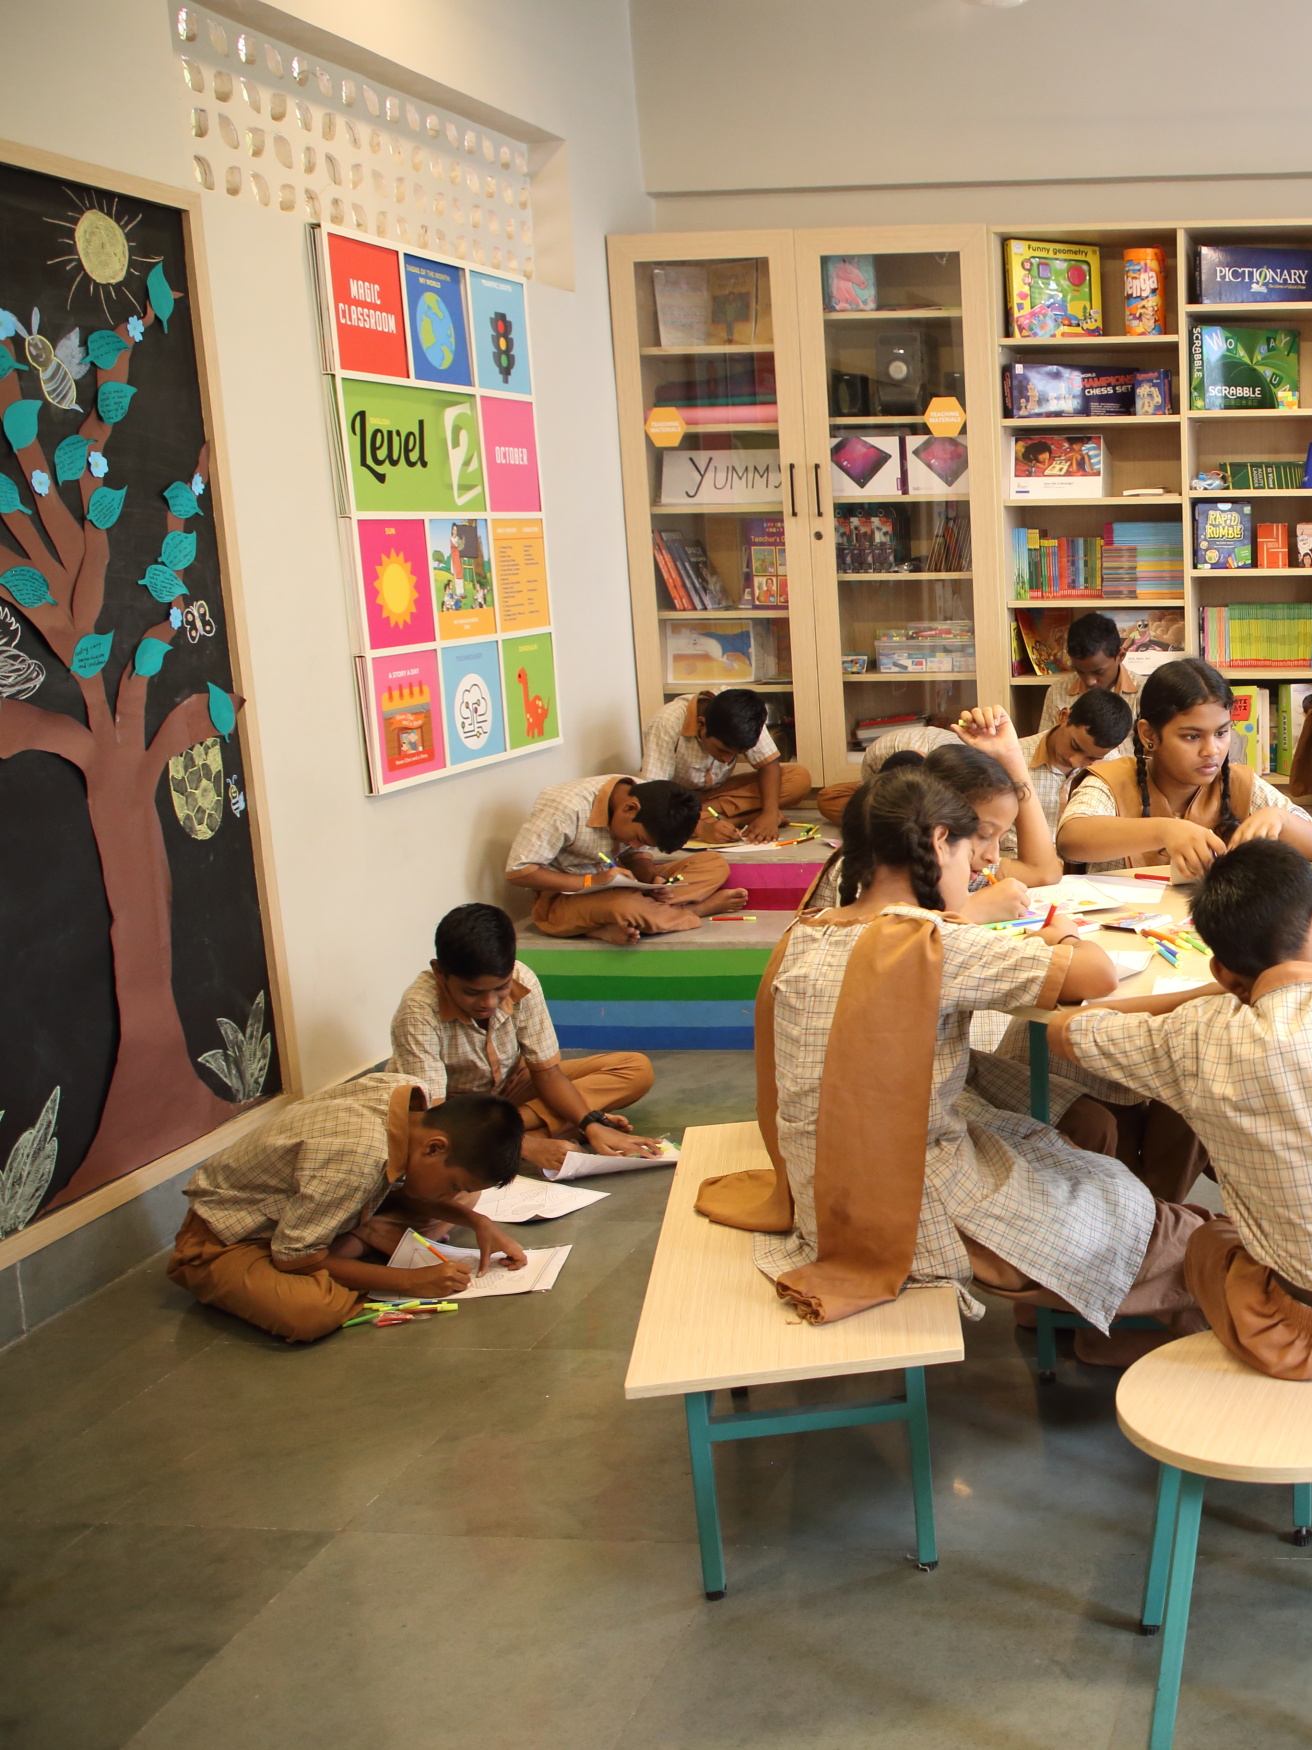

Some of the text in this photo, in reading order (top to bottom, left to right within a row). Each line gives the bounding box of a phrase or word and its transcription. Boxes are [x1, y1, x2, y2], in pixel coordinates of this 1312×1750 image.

[1028, 244, 1088, 257] Funny geometry
[1216, 266, 1308, 284] PICTIONARY
[350, 278, 381, 305] MAGIC
[338, 302, 396, 334] CLASSROOM
[1192, 328, 1203, 378] SCRABBLE
[1085, 385, 1132, 396] CHESS SET
[1208, 385, 1262, 398] SCRABBLE
[351, 408, 482, 503] Level 2
[495, 446, 528, 465] OCTOBER
[385, 527, 396, 535] SUN
[1207, 525, 1241, 538] RUMBLE
[751, 535, 779, 543] Teacher's
[392, 670, 406, 678] STORY
